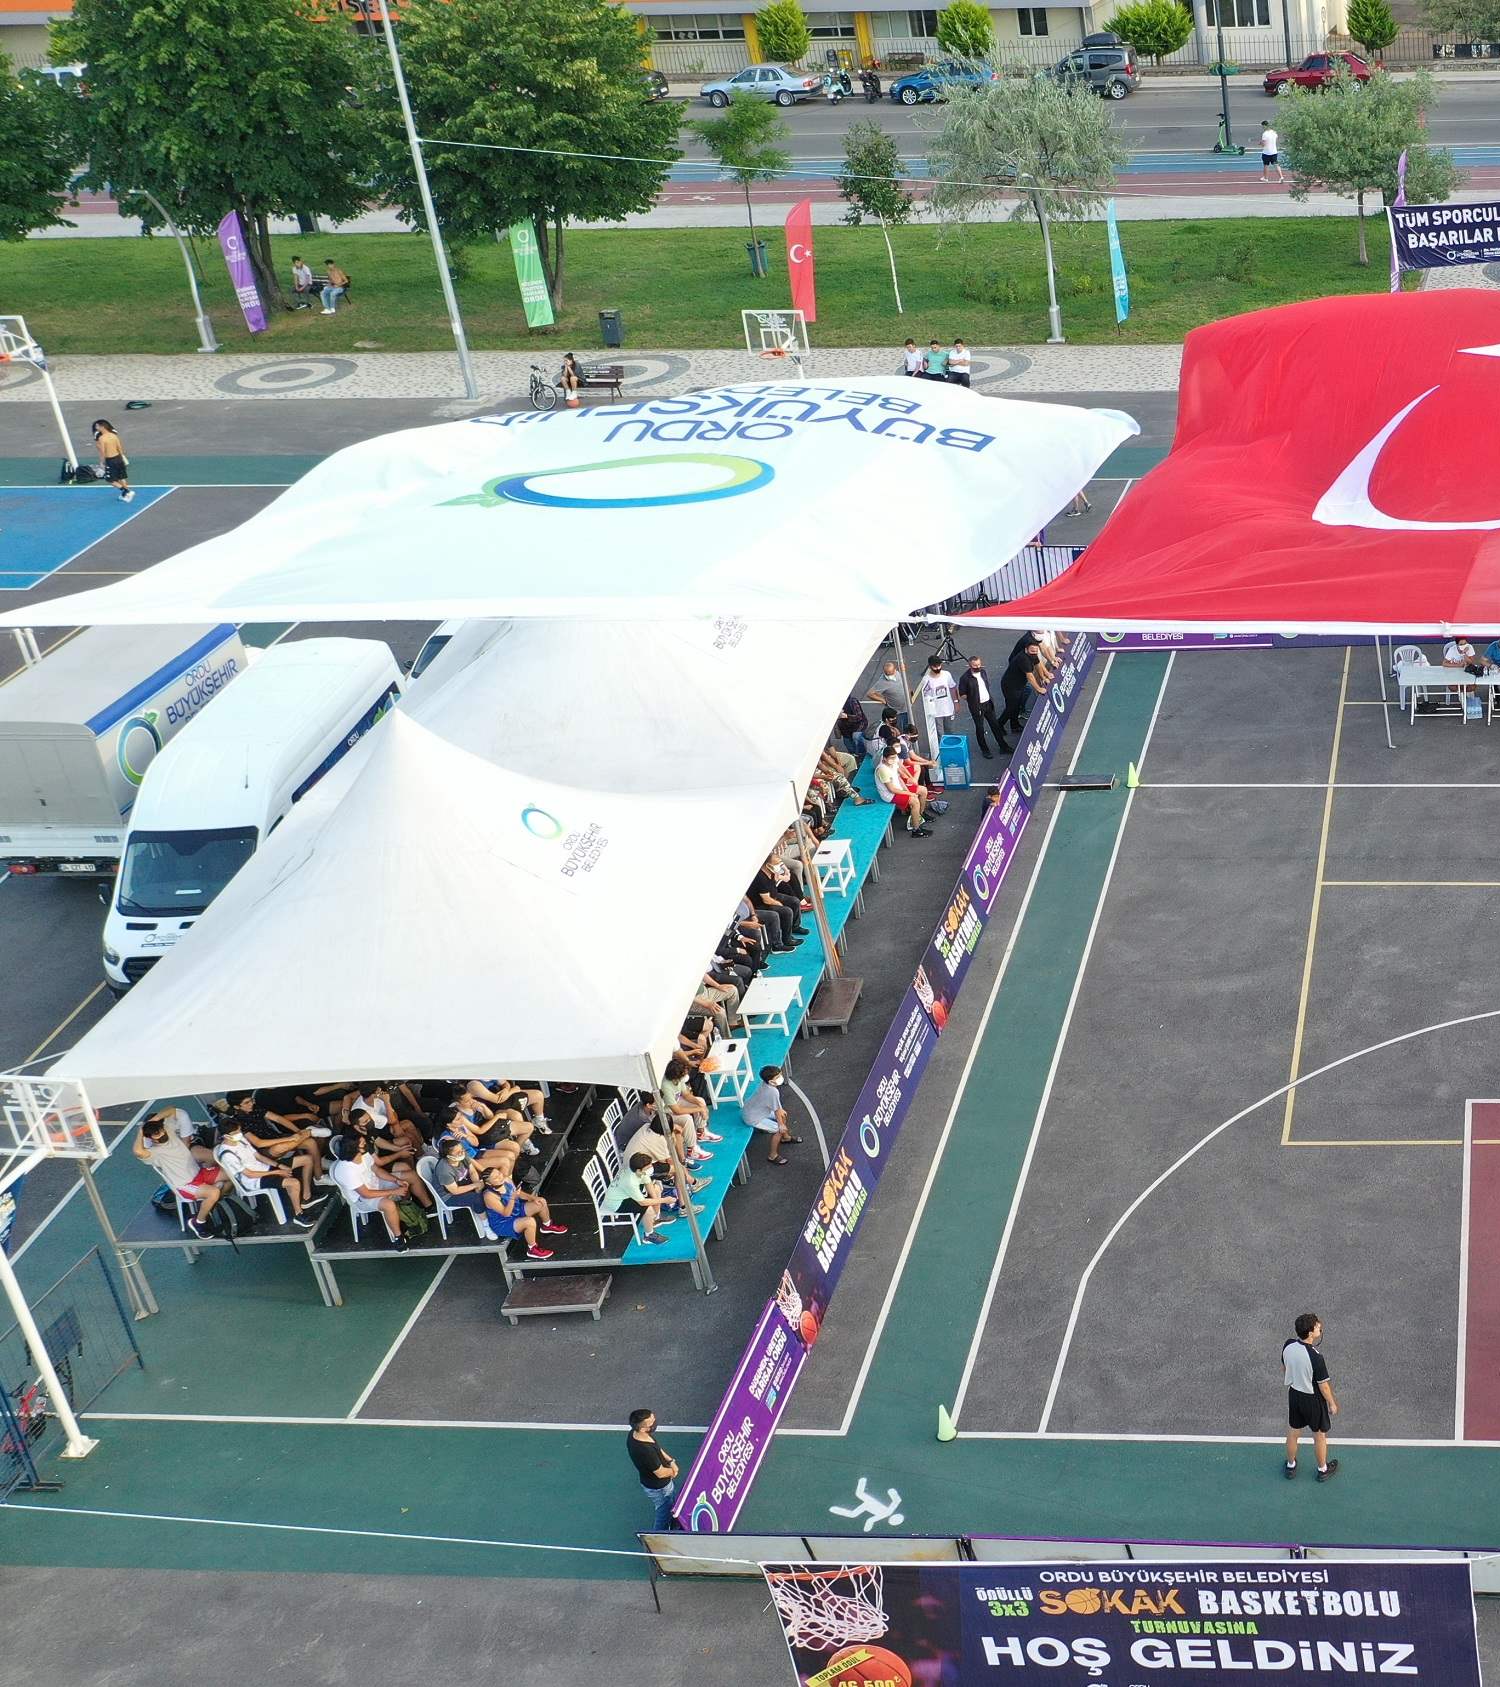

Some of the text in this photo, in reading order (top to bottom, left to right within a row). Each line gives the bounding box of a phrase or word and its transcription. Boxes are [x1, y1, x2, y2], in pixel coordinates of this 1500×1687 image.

[1395, 211, 1429, 229] TÜM
[1408, 227, 1494, 250] BAŞARILAR
[603, 420, 793, 443] ORDU
[185, 660, 212, 687] ORDU
[816, 1168, 863, 1274] BASKETBOLU
[772, 1331, 788, 1361] ORDU
[718, 1429, 735, 1463] ORDU
[1039, 1569, 1329, 1586] ORDU BÜYÜKŞEHİR BELEDİYESİ
[975, 1586, 1034, 1601] ÖDÜLLÜ
[1039, 1587, 1186, 1616] SOKAK
[1198, 1588, 1401, 1617] BASKETBOLU
[1130, 1618, 1260, 1635] TURNUVASINA
[815, 1655, 862, 1683] TOPLAM ÖDÜL
[981, 1636, 1419, 1676] HOŞ GELDİNİZ
